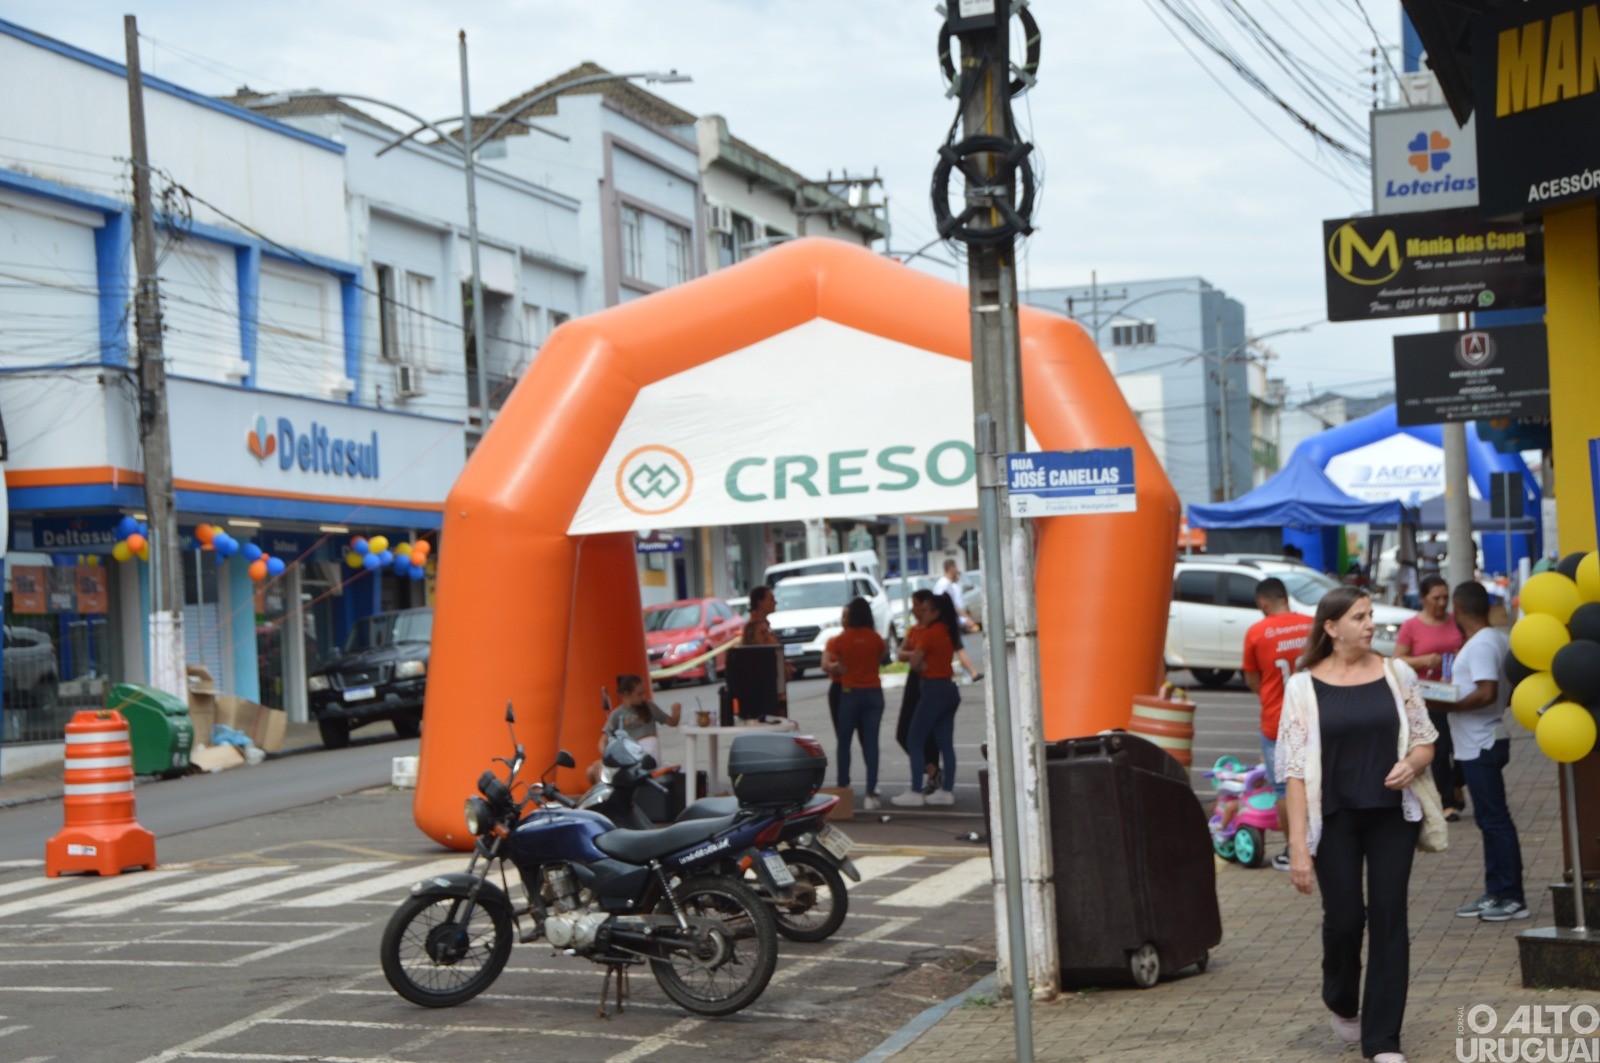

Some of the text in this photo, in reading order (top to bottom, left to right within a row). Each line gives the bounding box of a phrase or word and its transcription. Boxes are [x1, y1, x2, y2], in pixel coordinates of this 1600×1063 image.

[1385, 175, 1477, 197] Loterias
[1527, 168, 1600, 203] ACESSÓR
[1406, 231, 1526, 258] Mania das Capa
[278, 416, 379, 479] Deltasul
[724, 440, 977, 503] CRESO
[1011, 458, 1034, 471] RUA
[1011, 467, 1120, 488] JOSÉ CANELLAS
[42, 529, 115, 546] Deltasu
